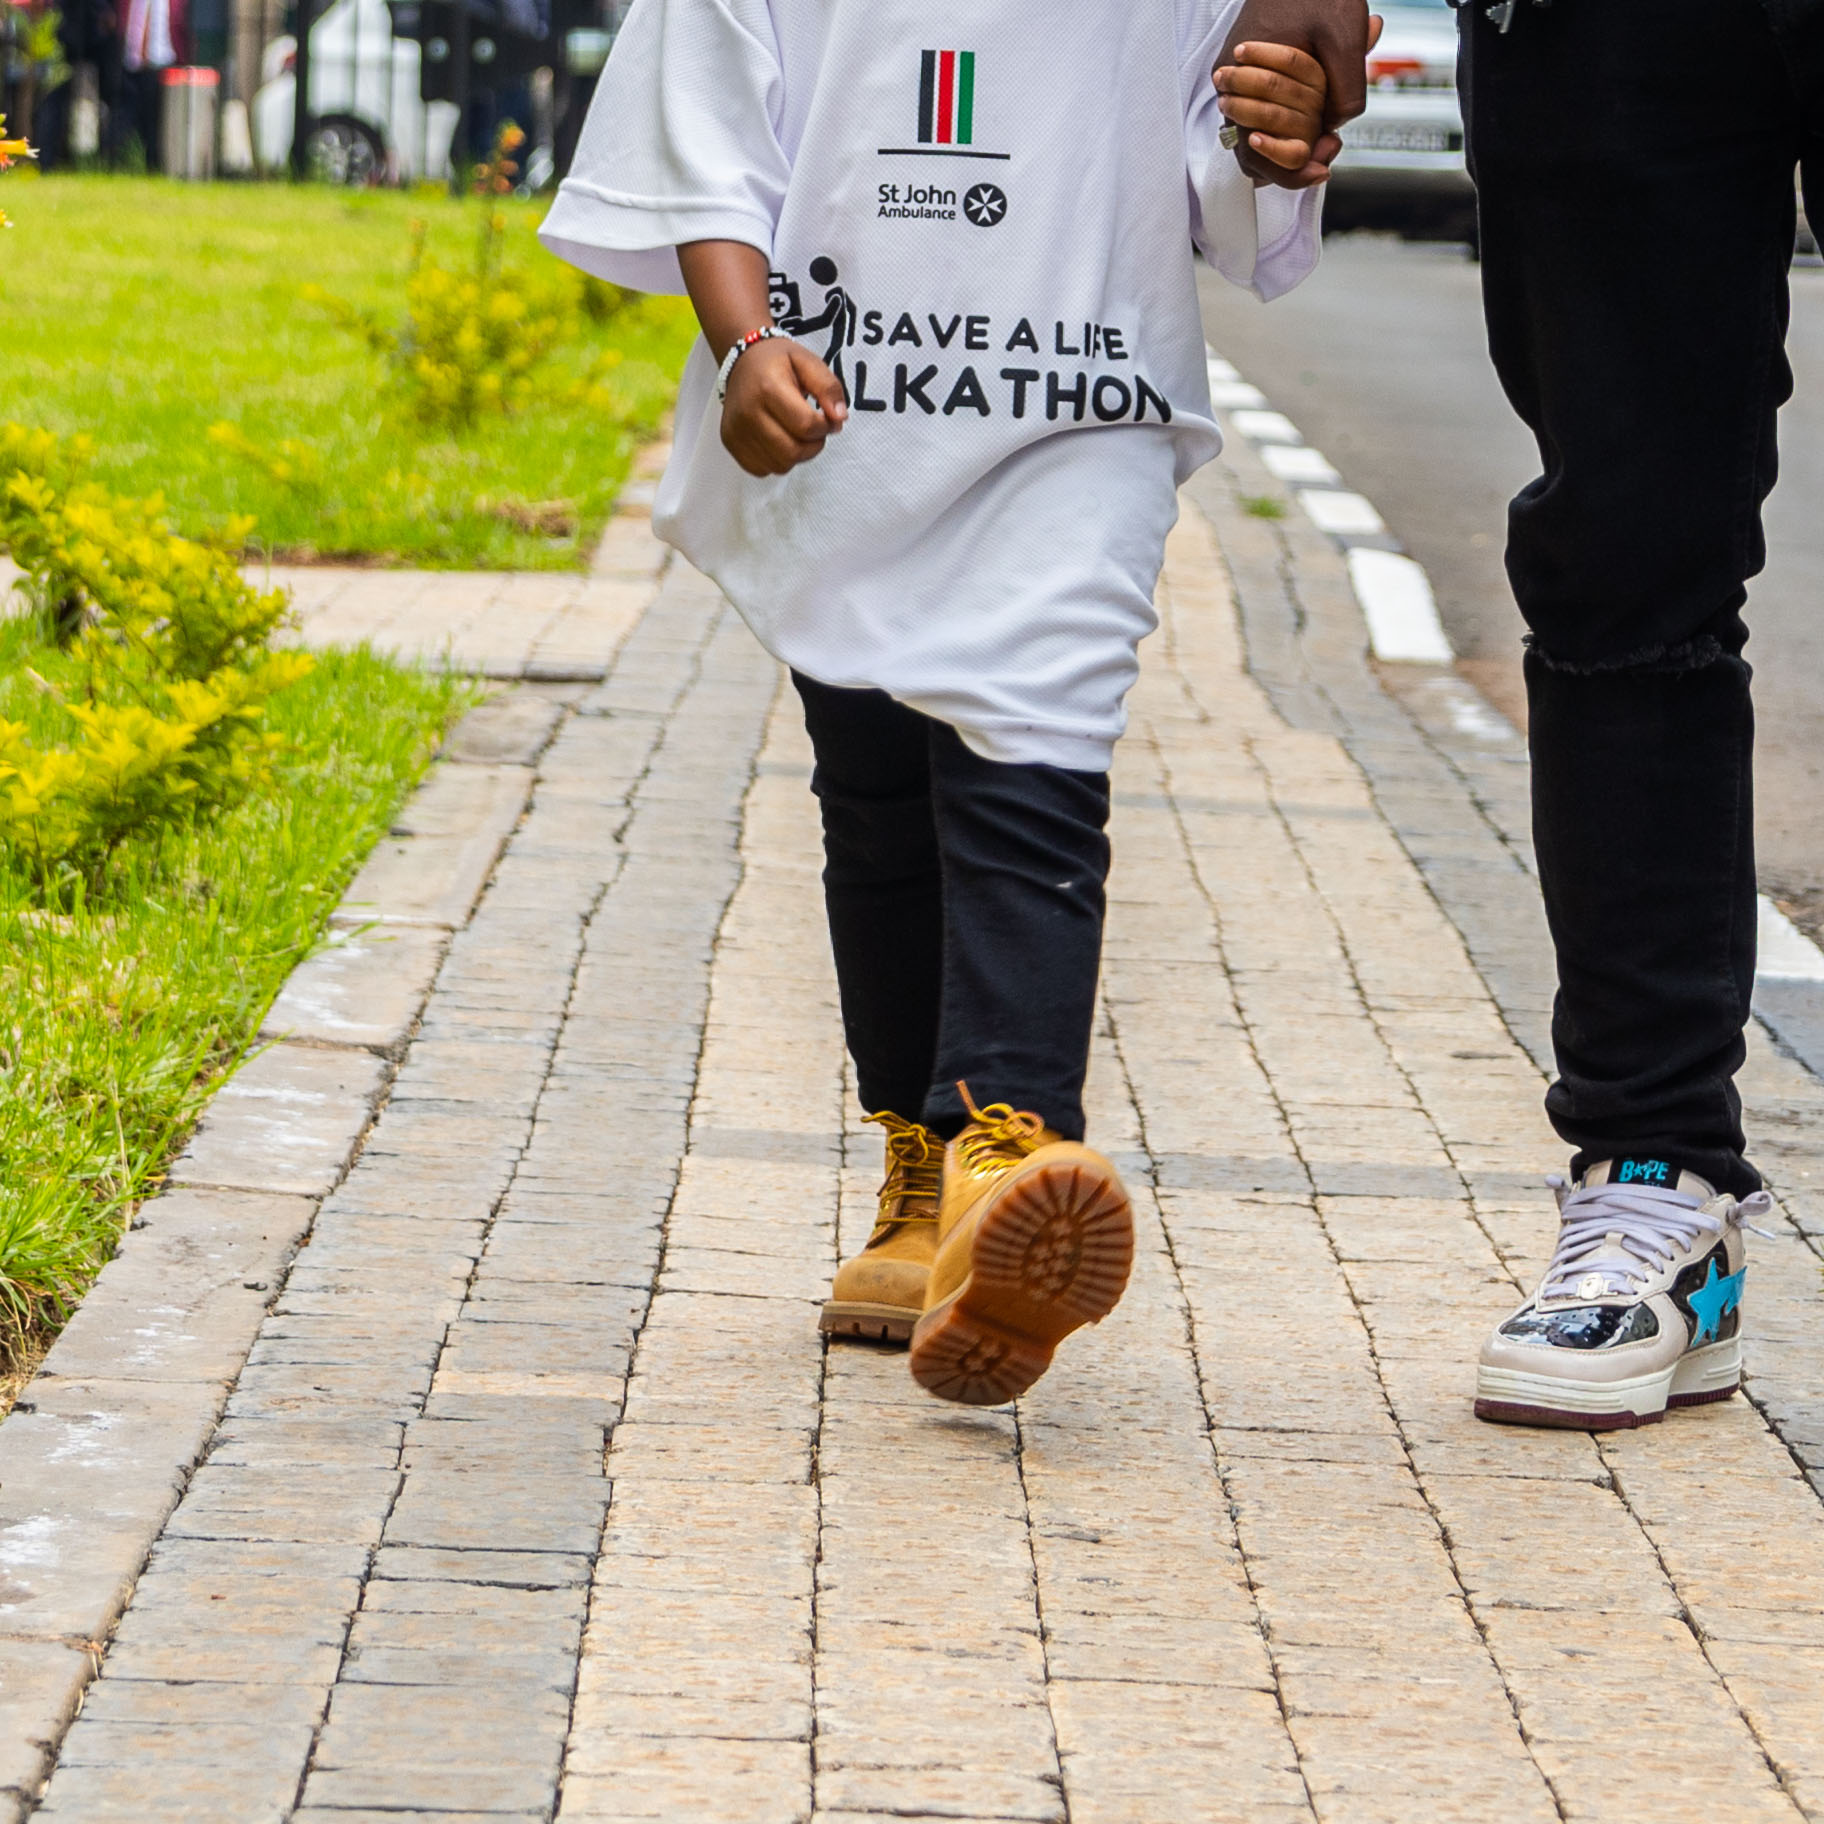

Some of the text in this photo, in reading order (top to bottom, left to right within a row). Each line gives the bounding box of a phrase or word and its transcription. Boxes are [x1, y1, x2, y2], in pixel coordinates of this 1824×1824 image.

[877, 183, 957, 206] St John
[877, 204, 957, 221] Ambulance
[862, 310, 1129, 361] SAVE A LIFE
[840, 360, 1173, 425] LKATHON
